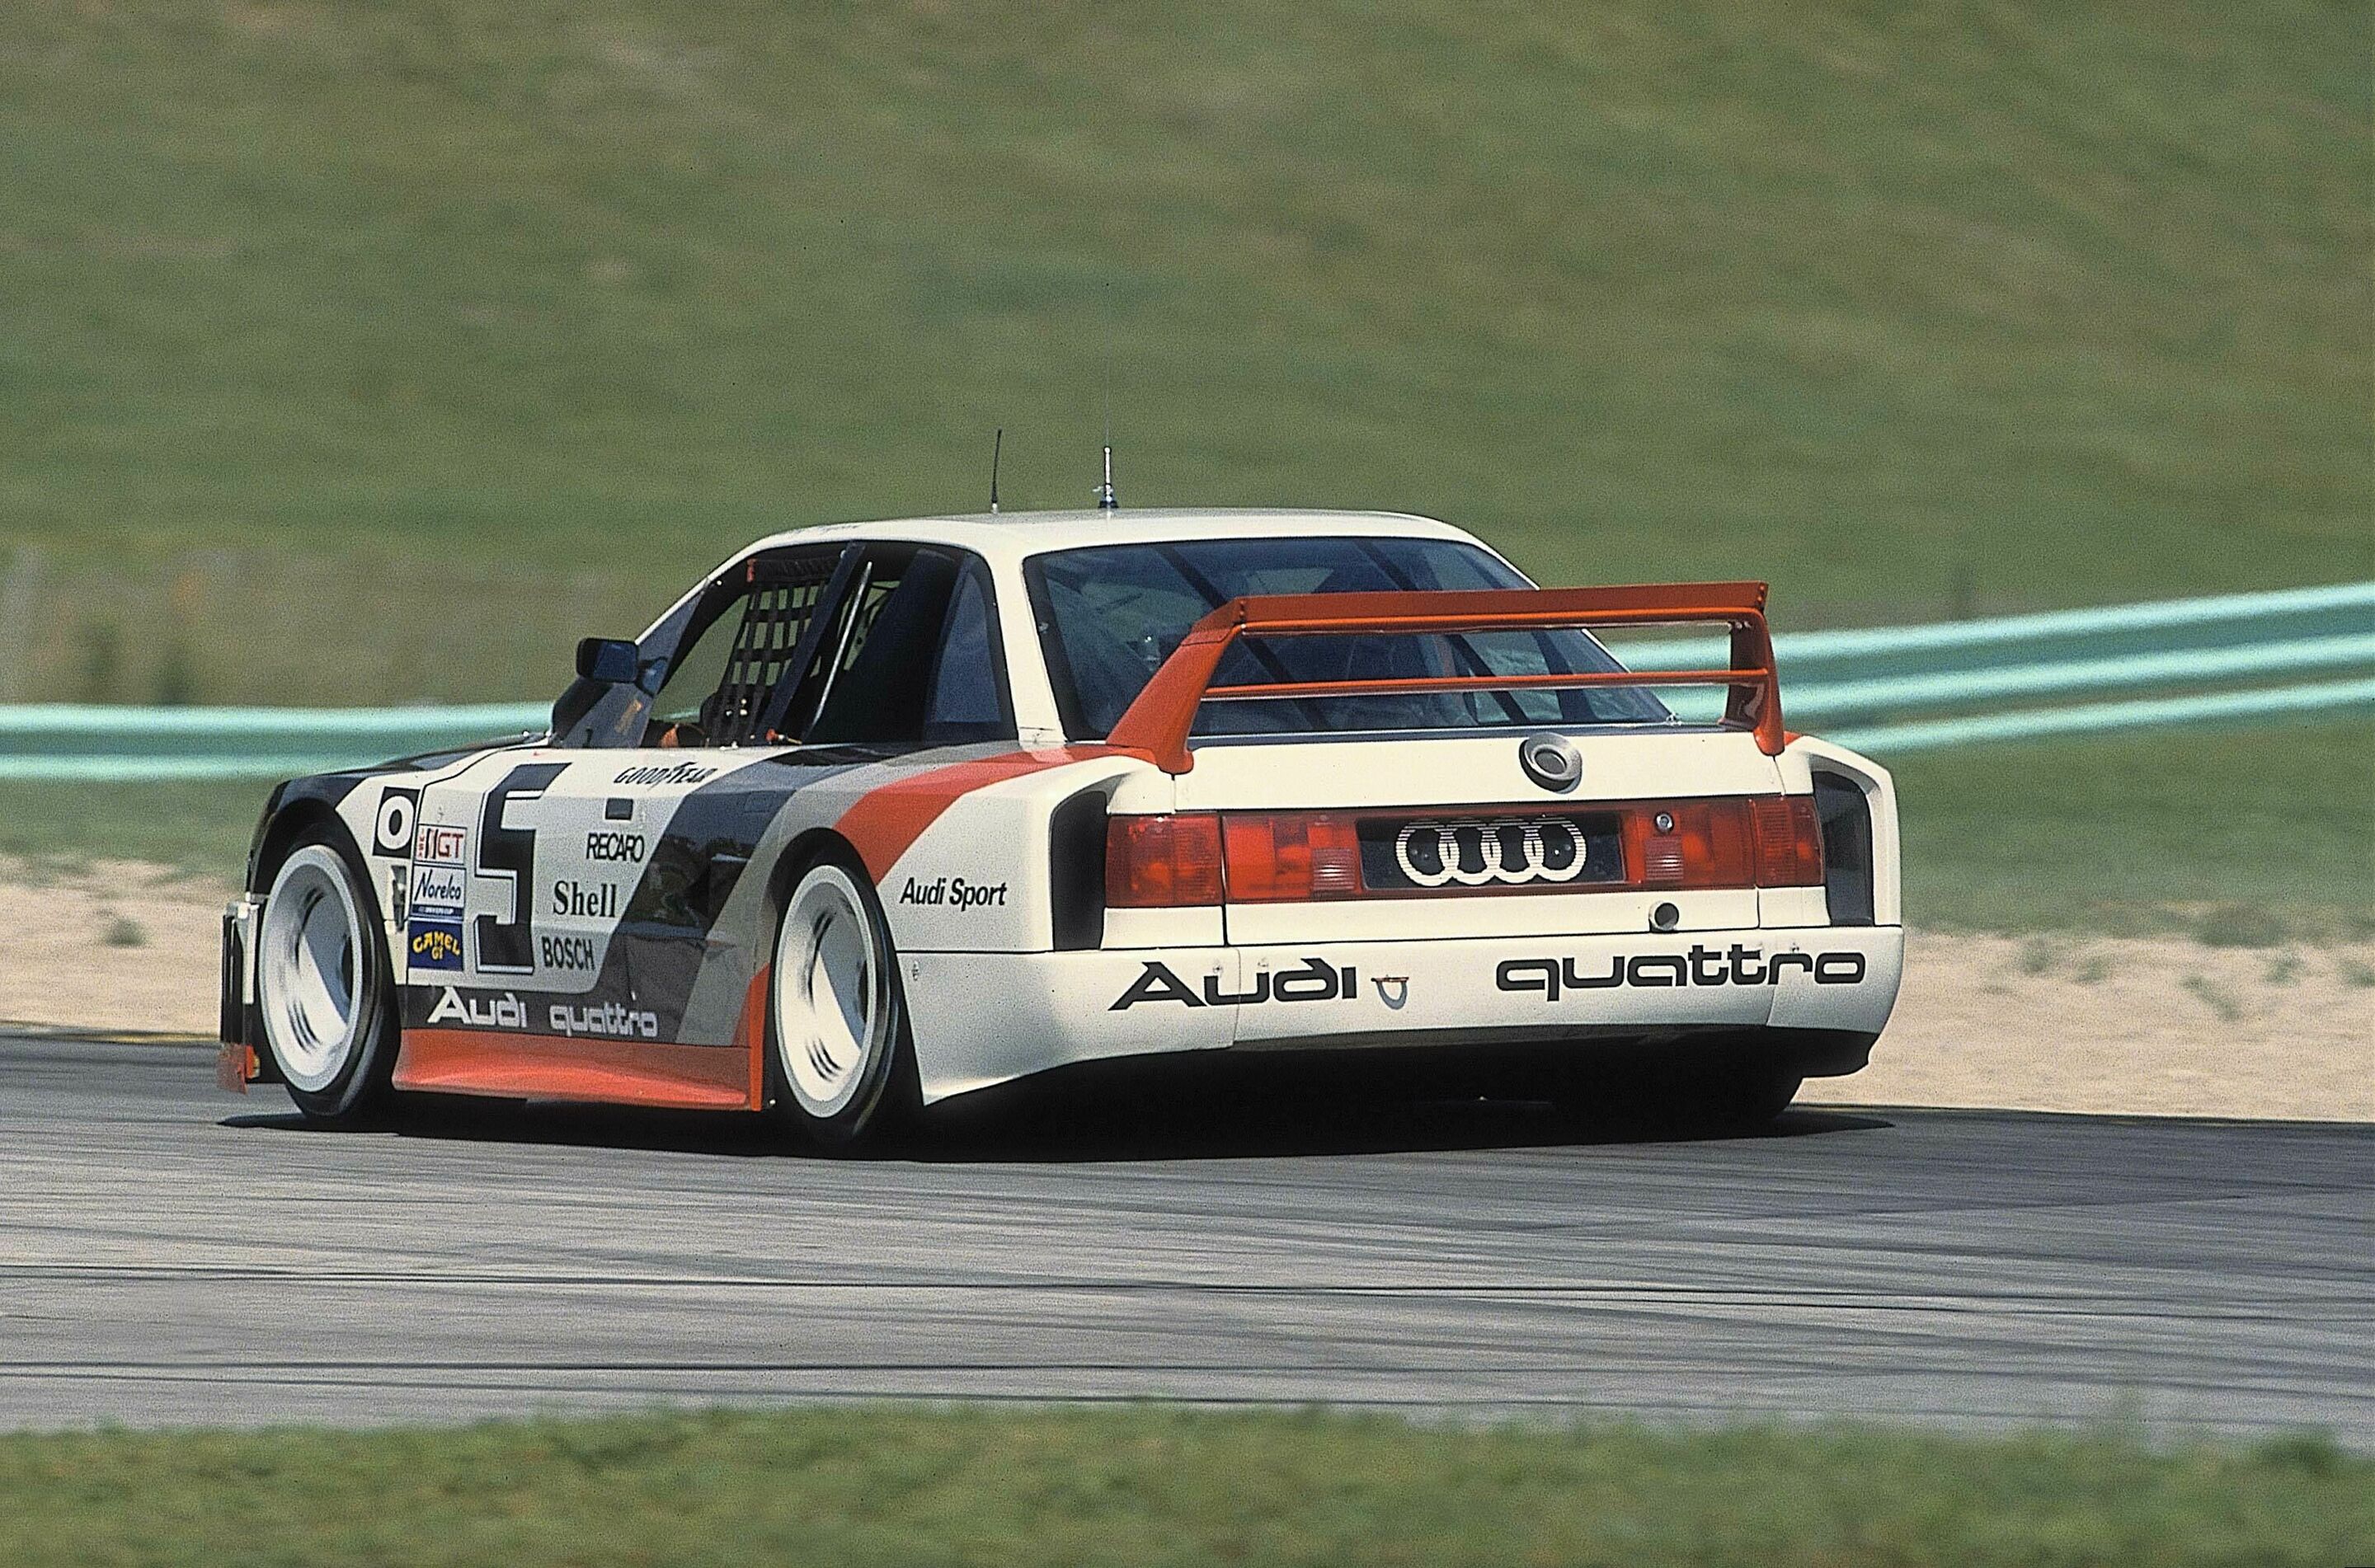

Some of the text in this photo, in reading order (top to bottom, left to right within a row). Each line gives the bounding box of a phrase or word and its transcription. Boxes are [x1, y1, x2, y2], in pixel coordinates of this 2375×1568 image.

[586, 833, 645, 862] RECARO
[414, 869, 461, 901] Norelco
[474, 763, 572, 974] 5
[553, 880, 616, 918] Shell
[899, 877, 1007, 912] Audi Sport
[412, 931, 460, 956] CAMEL
[541, 937, 595, 971] BOSCH
[1108, 944, 1865, 1011] Audi quattro
[427, 986, 658, 1037] Audi quattro
